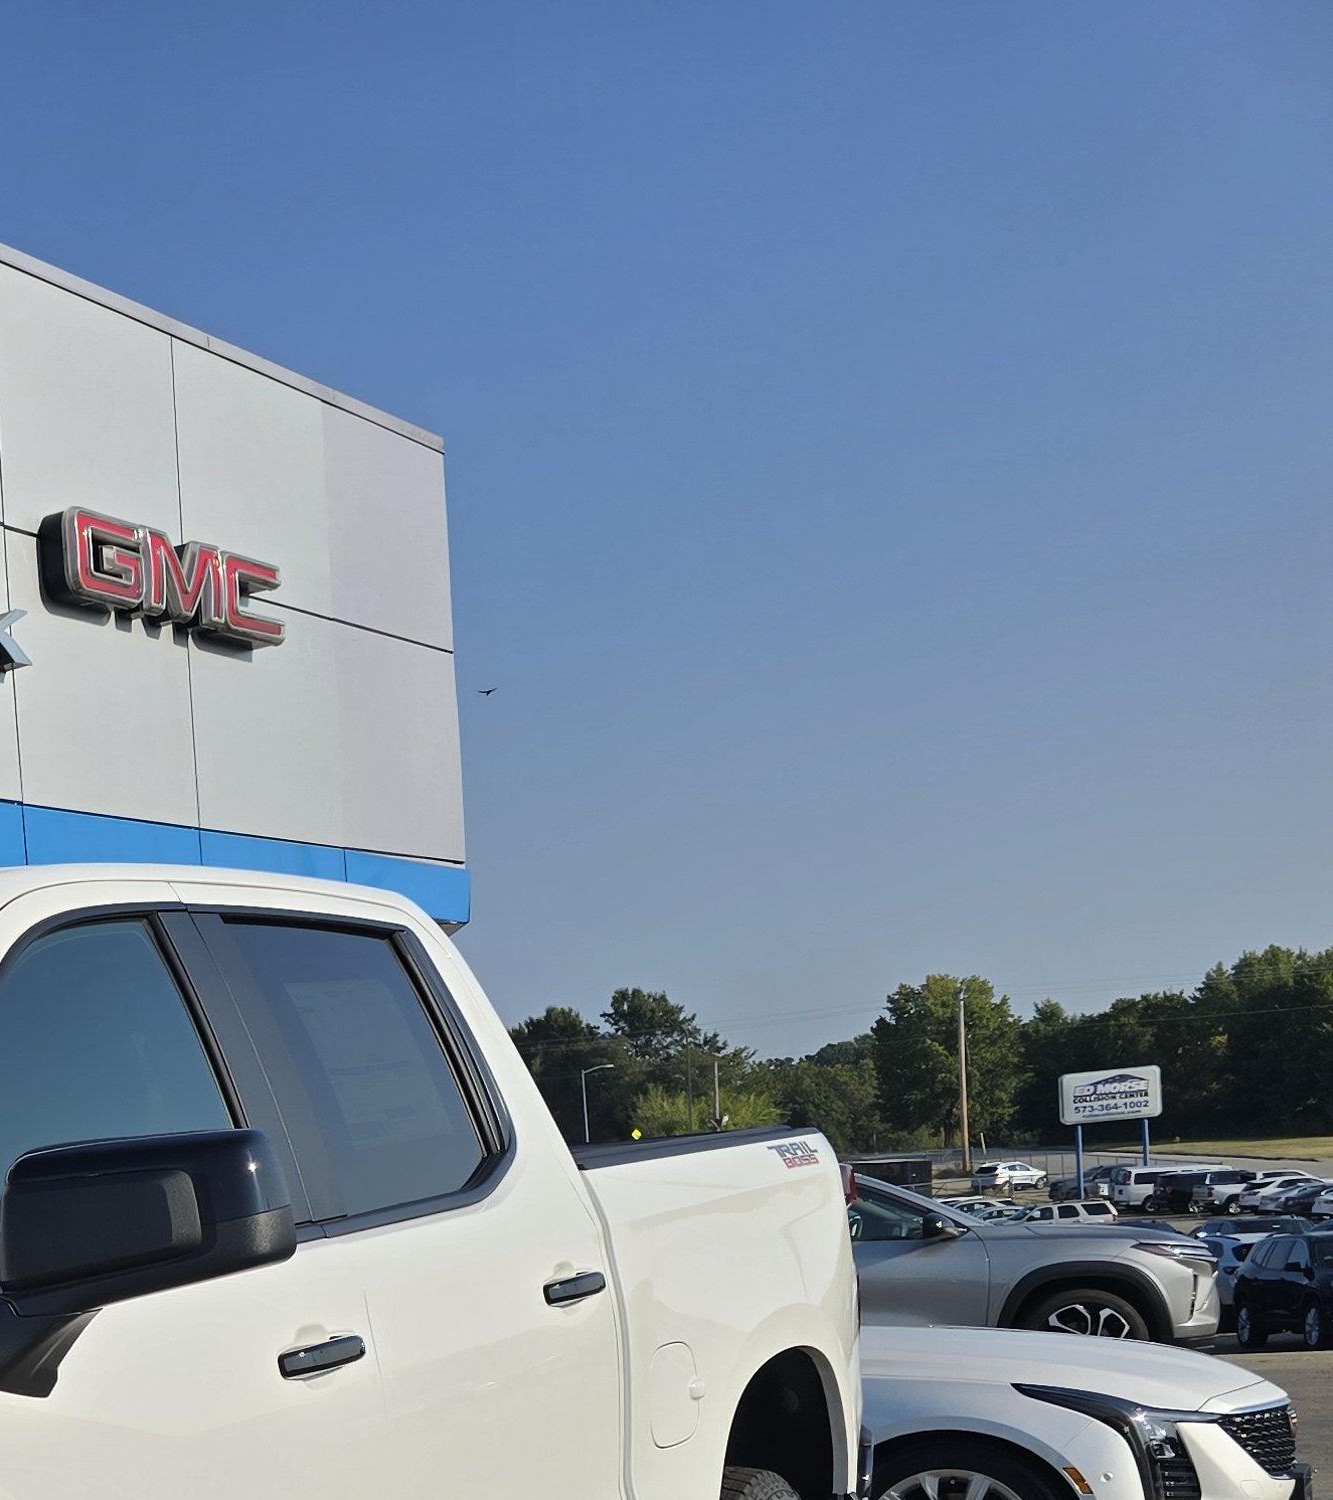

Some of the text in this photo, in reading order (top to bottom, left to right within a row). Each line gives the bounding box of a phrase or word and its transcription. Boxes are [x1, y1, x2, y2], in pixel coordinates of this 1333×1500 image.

[58, 506, 286, 648] GMC
[1074, 1081, 1149, 1096] ED MORSE
[1073, 1091, 1149, 1104] COLLISION CENTER
[1074, 1100, 1150, 1114] 573-364-1002
[767, 1141, 819, 1158] TRAIL
[783, 1154, 819, 1168] BOSS
